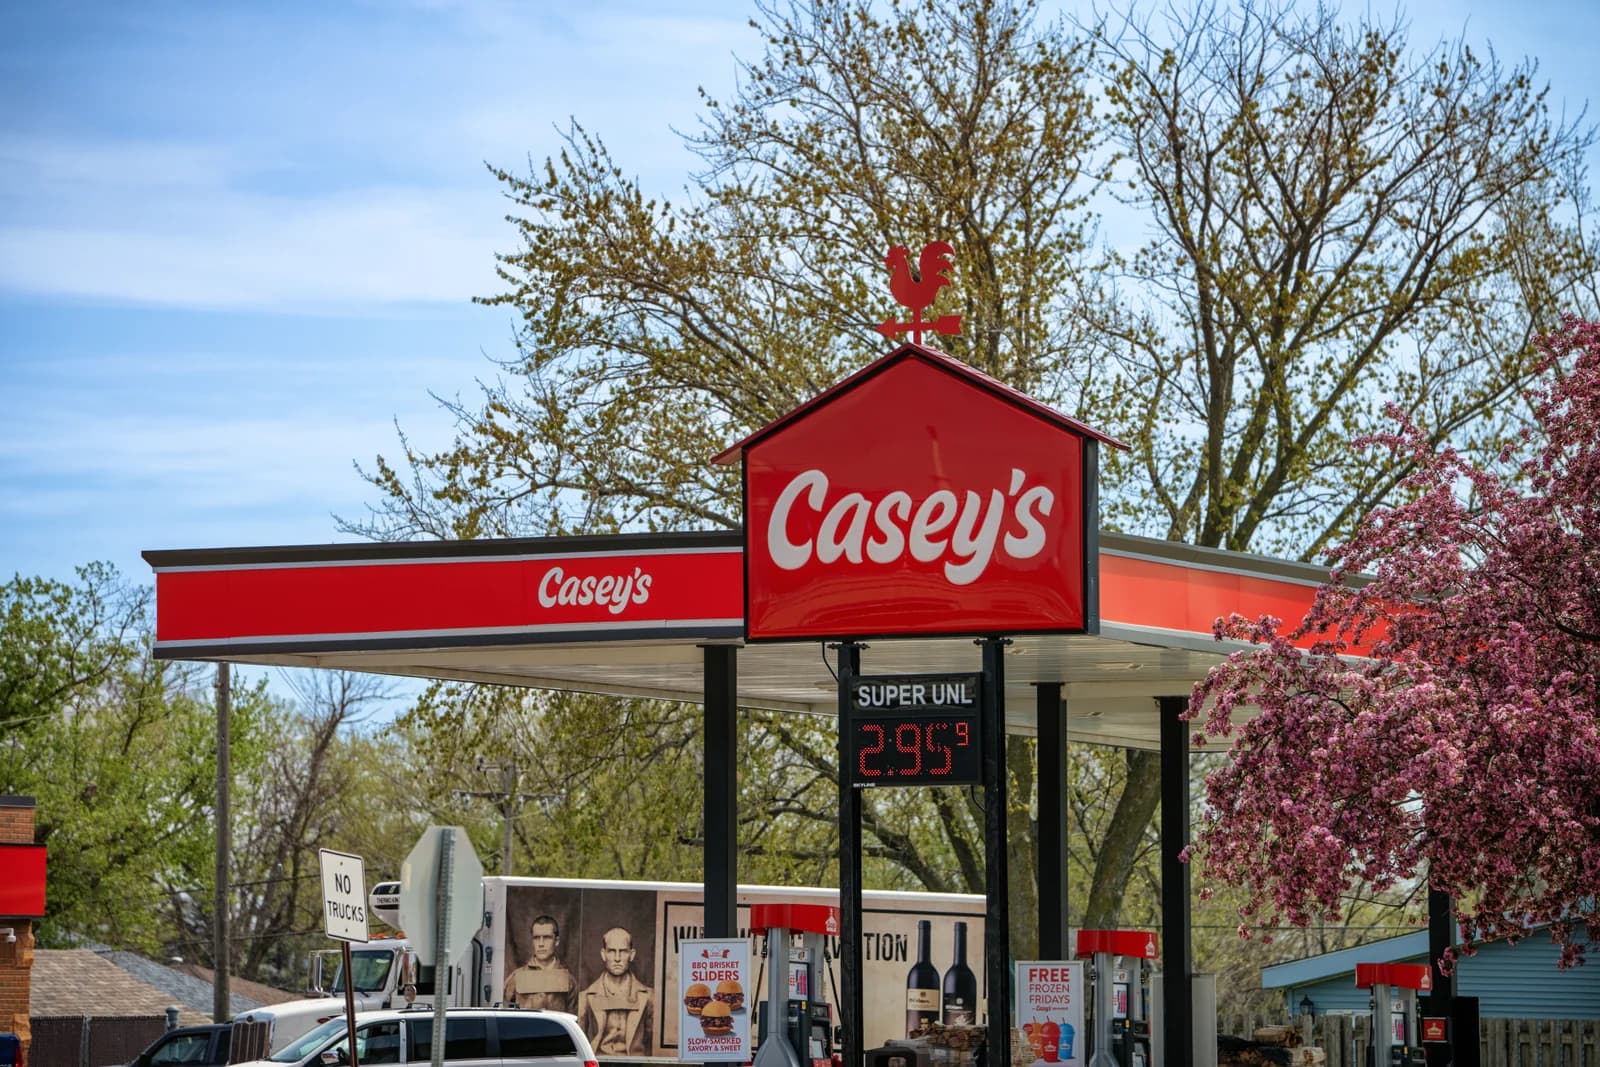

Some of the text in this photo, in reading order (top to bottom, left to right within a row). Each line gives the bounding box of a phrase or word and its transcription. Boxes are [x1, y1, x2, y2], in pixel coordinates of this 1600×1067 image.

[767, 468, 1054, 585] Casey's
[538, 566, 652, 614] Casey's
[858, 683, 973, 707] SUPER UNL
[334, 872, 352, 895] NO
[327, 900, 365, 923] TRUCKS
[692, 961, 739, 970] BBQ BRISKET
[692, 970, 739, 981] SLIDERS
[1029, 968, 1070, 982] FREE
[1029, 984, 1070, 993] FROZEN
[1029, 994, 1070, 1004] FRIDAYS
